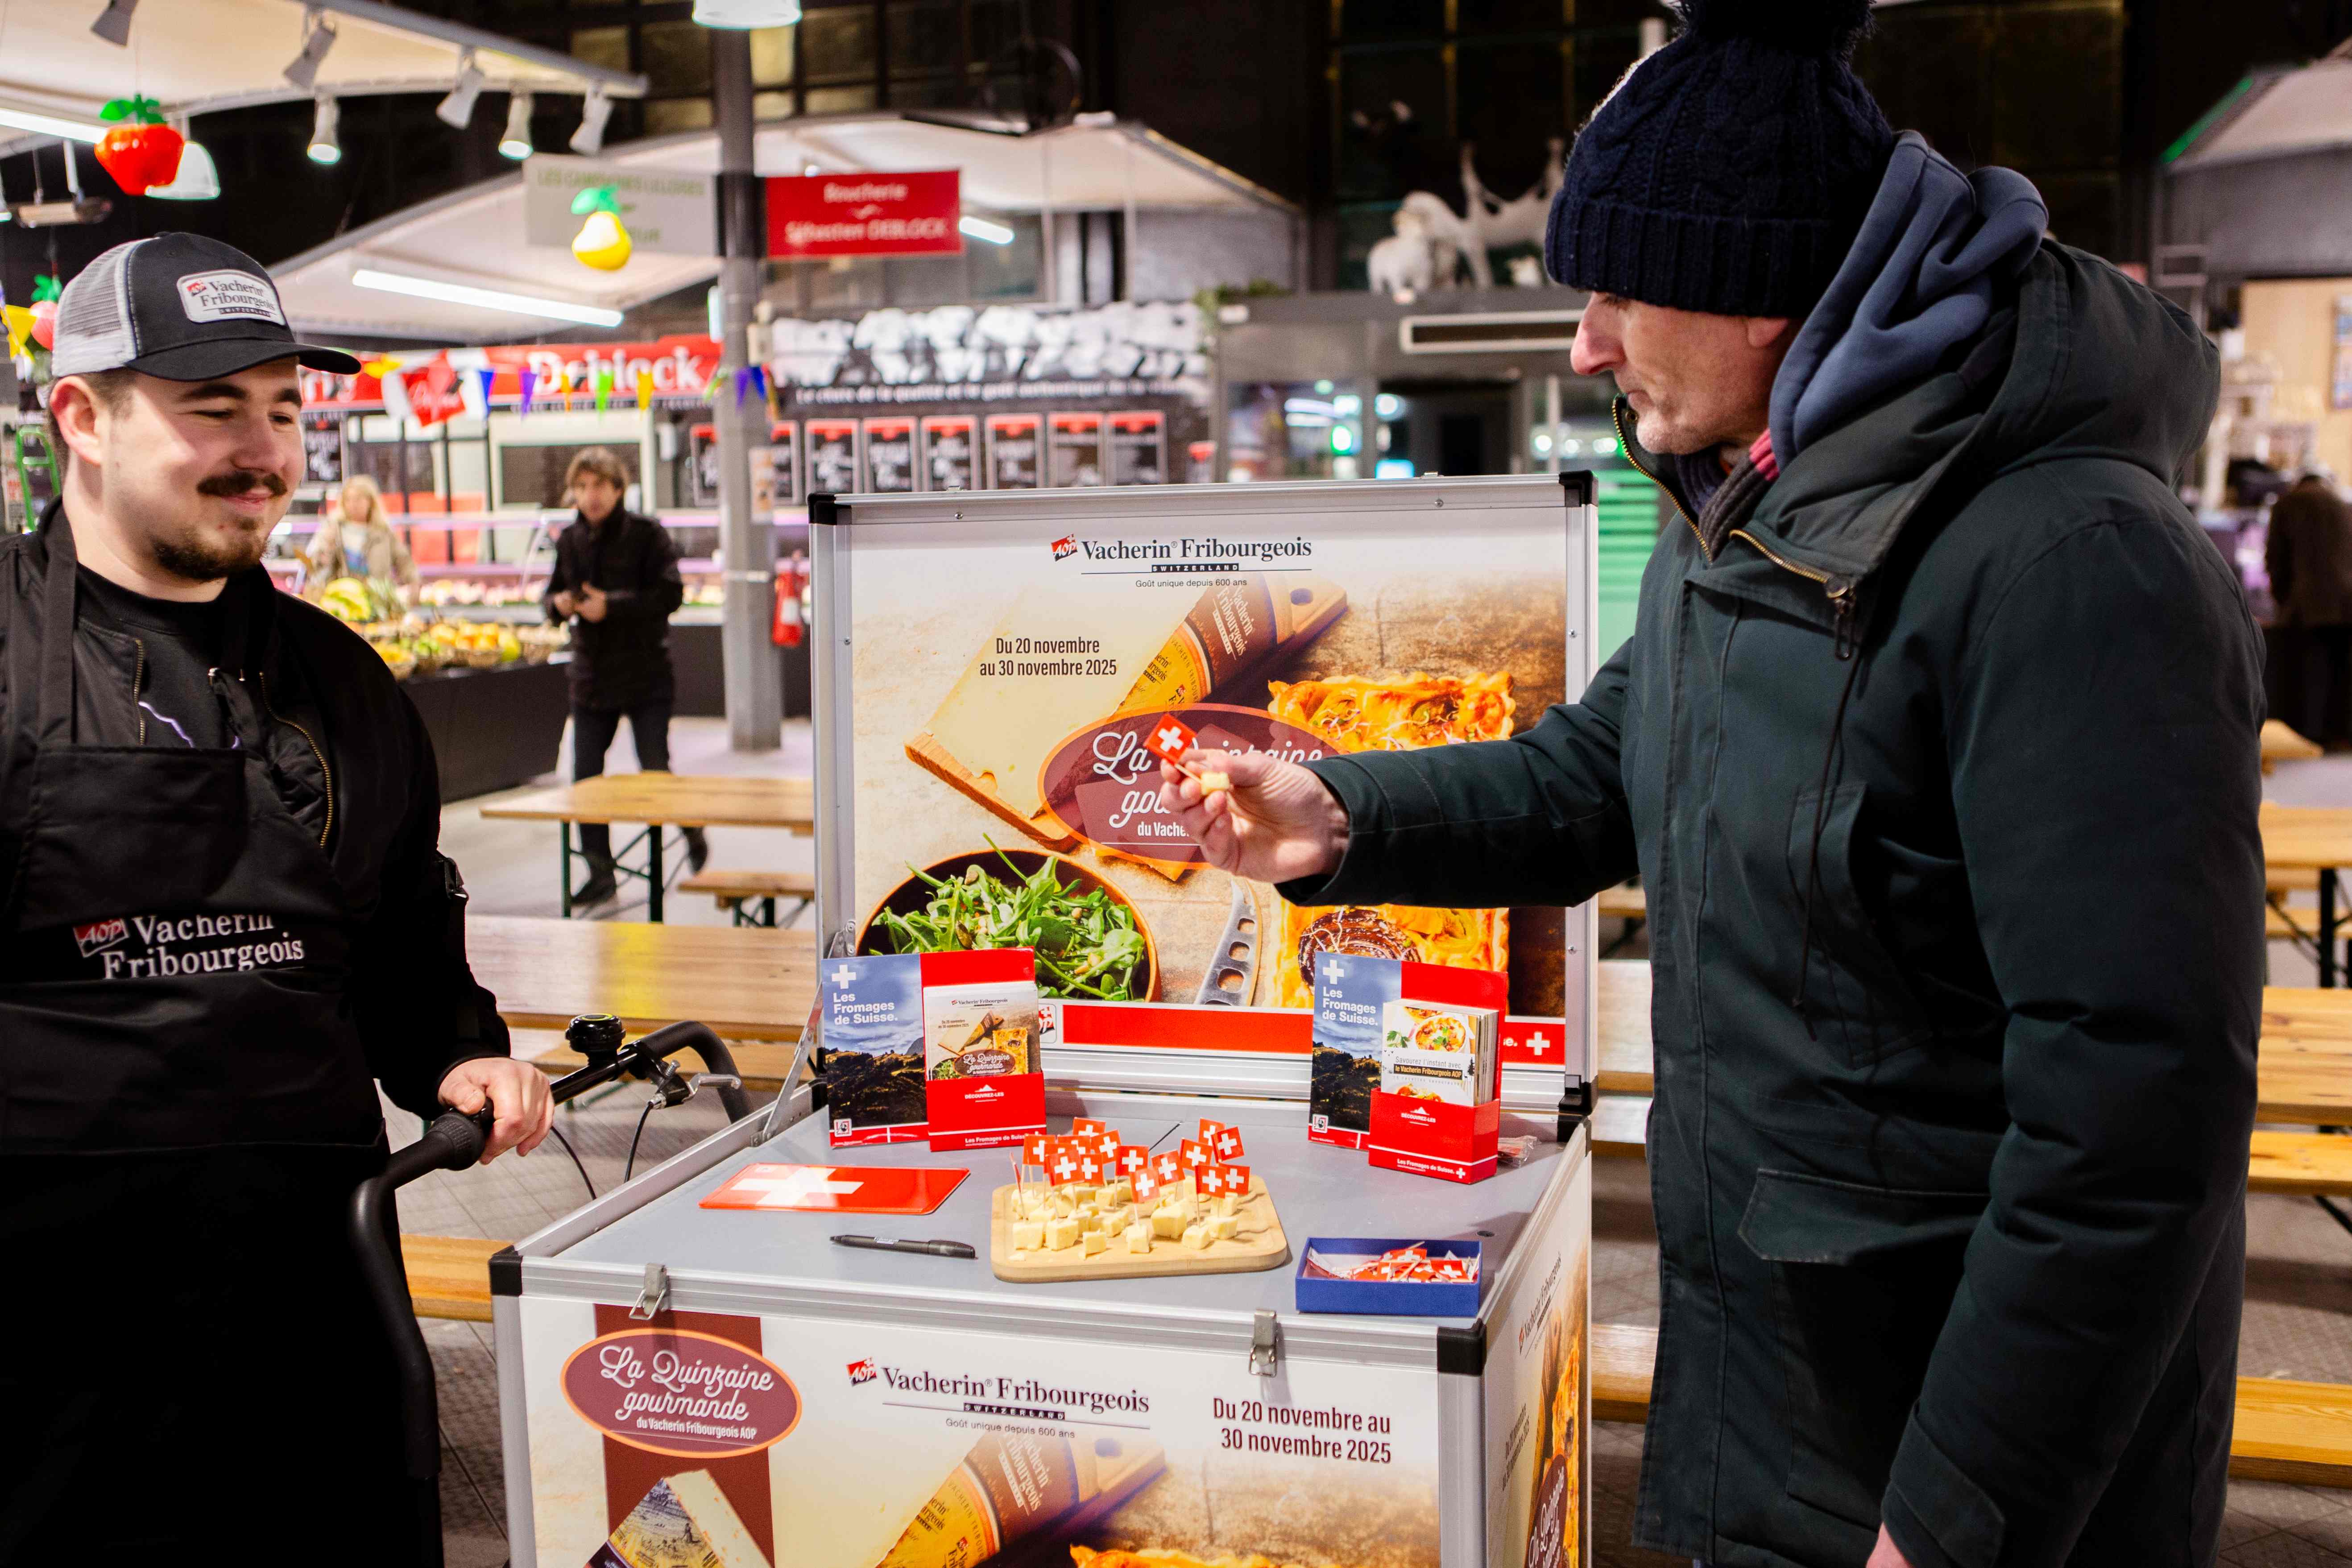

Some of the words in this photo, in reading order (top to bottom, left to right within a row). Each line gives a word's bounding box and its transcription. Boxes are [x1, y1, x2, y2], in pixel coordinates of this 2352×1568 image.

[201, 293, 275, 311] Fribourgeois
[1180, 537, 1311, 561] Fribourgeois
[1135, 579, 1155, 587] Goût
[1157, 579, 1184, 588] unique
[1186, 579, 1213, 588] depuis
[1217, 587, 1247, 656] Fribourgeois
[996, 638, 1012, 654] Du
[1016, 638, 1031, 654] 20
[1034, 637, 1100, 654] novembre
[980, 663, 995, 676] au
[999, 660, 1014, 676] 30
[1018, 659, 1082, 676] novembre
[1086, 659, 1117, 675] 2025
[1093, 731, 1152, 785] La
[1138, 822, 1151, 836] du
[1154, 822, 1189, 837] Vache
[79, 921, 122, 944] AOP
[101, 932, 304, 979] Fribourgeois
[833, 993, 856, 1002] Les
[1323, 986, 1342, 998] Les
[834, 1002, 895, 1014] Fromages
[1323, 998, 1376, 1014] Fromages
[834, 1015, 850, 1025] de
[853, 1013, 898, 1024] Suisse.
[1322, 1010, 1336, 1020] de
[1339, 1011, 1378, 1026] Suisse.
[963, 1054, 976, 1065] La
[977, 1054, 1010, 1063] Quinzaine
[967, 1061, 1003, 1073] gourmande
[1395, 1056, 1421, 1065] Savourez
[1424, 1059, 1446, 1067] l'instant
[1422, 1068, 1451, 1077] Fribourgeois
[1401, 1113, 1436, 1123] DÉCOUVREZ-LES
[1406, 1160, 1430, 1169] Fromages
[599, 1345, 645, 1389] La
[651, 1349, 774, 1398] Quinzaine
[995, 1378, 1149, 1413] Fribourgeois
[615, 1390, 749, 1421] gourmande
[965, 1404, 1064, 1420] SWITZERLAND
[1213, 1398, 1236, 1420] Du
[1241, 1401, 1263, 1422] 20
[1268, 1407, 1362, 1432] novembre
[1368, 1415, 1391, 1435] au
[637, 1416, 648, 1429] du
[649, 1417, 684, 1433] Vacherin
[687, 1421, 738, 1439] Fribourgeois
[740, 1426, 756, 1440] AOP
[946, 1419, 967, 1427] Goût
[971, 1423, 1002, 1432] unique
[1005, 1424, 1035, 1435] depuis
[1039, 1427, 1055, 1436] 600
[1221, 1427, 1242, 1450] 30
[1248, 1435, 1342, 1459] novembre
[1347, 1439, 1391, 1465] 2025
